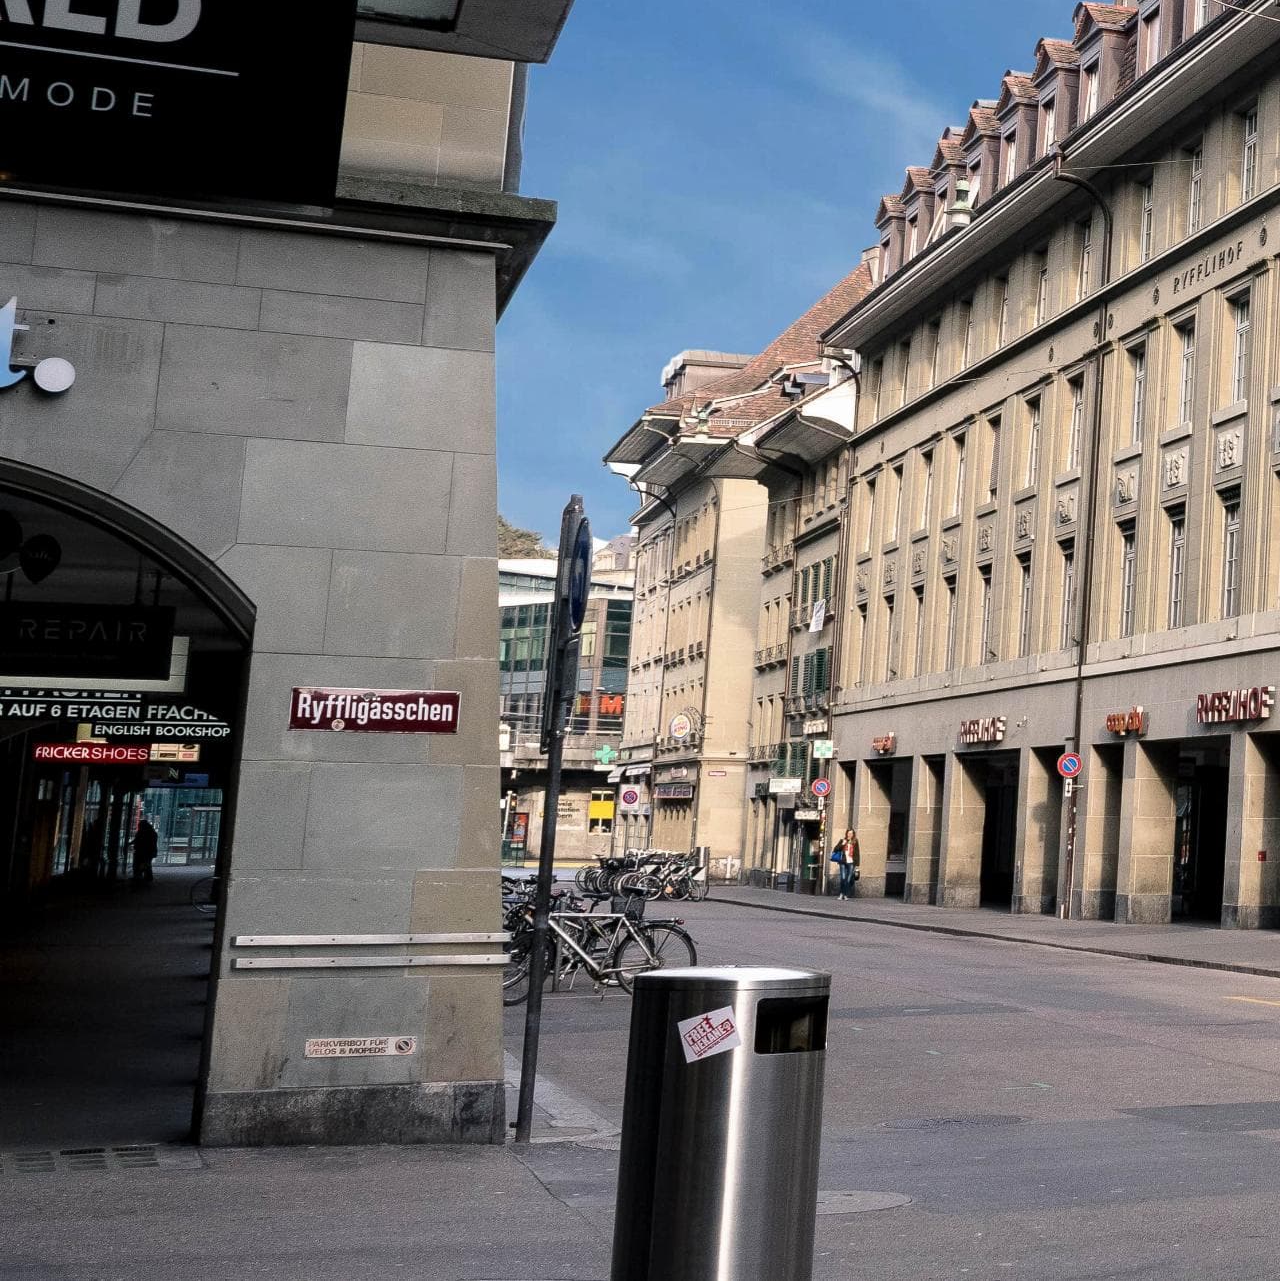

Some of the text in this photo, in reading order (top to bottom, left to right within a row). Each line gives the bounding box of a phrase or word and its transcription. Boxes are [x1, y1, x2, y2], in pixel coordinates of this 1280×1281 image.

[0, 75, 154, 117] MODE
[19, 619, 148, 642] REPAIR
[8, 703, 47, 717] AUF
[51, 704, 62, 717] 6
[67, 705, 141, 719] ETAGEN
[296, 693, 453, 725] Ryffligässchen
[95, 725, 231, 737] ENGLISH BOOKSHOP
[685, 1019, 714, 1046] FREE
[308, 1038, 387, 1048] PARKVERBOT FÜR
[308, 1048, 336, 1056] VELOS
[349, 1047, 387, 1055] MOPEDS
